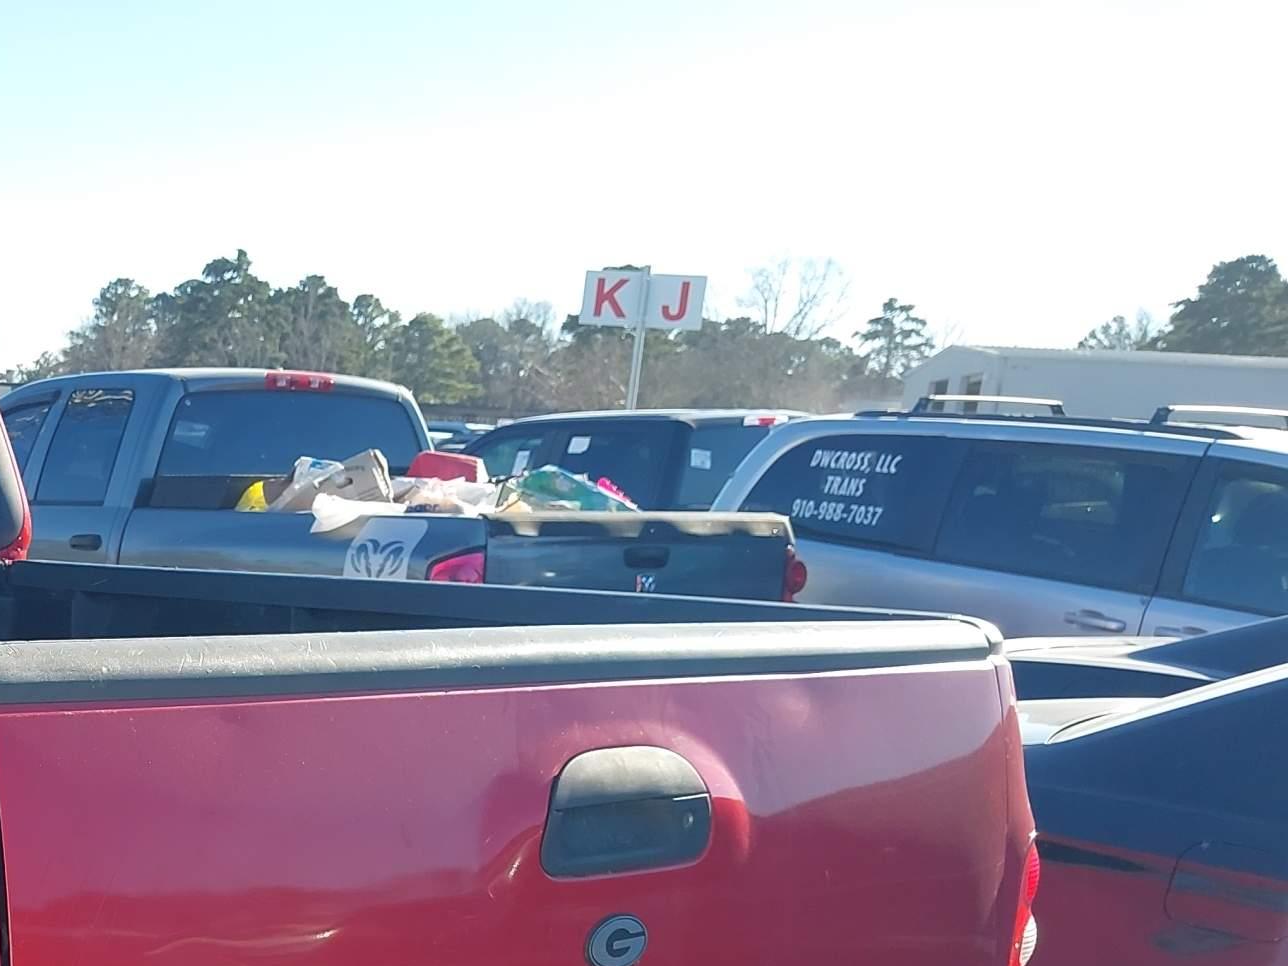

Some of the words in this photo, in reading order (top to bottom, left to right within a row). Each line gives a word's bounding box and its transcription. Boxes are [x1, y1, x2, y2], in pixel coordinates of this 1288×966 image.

[593, 278, 629, 318] K
[662, 281, 691, 321] J
[810, 450, 871, 473] DWCROSS,
[875, 454, 902, 473] LLC
[823, 475, 866, 497] TRANS
[791, 499, 883, 526] 910-988-7037
